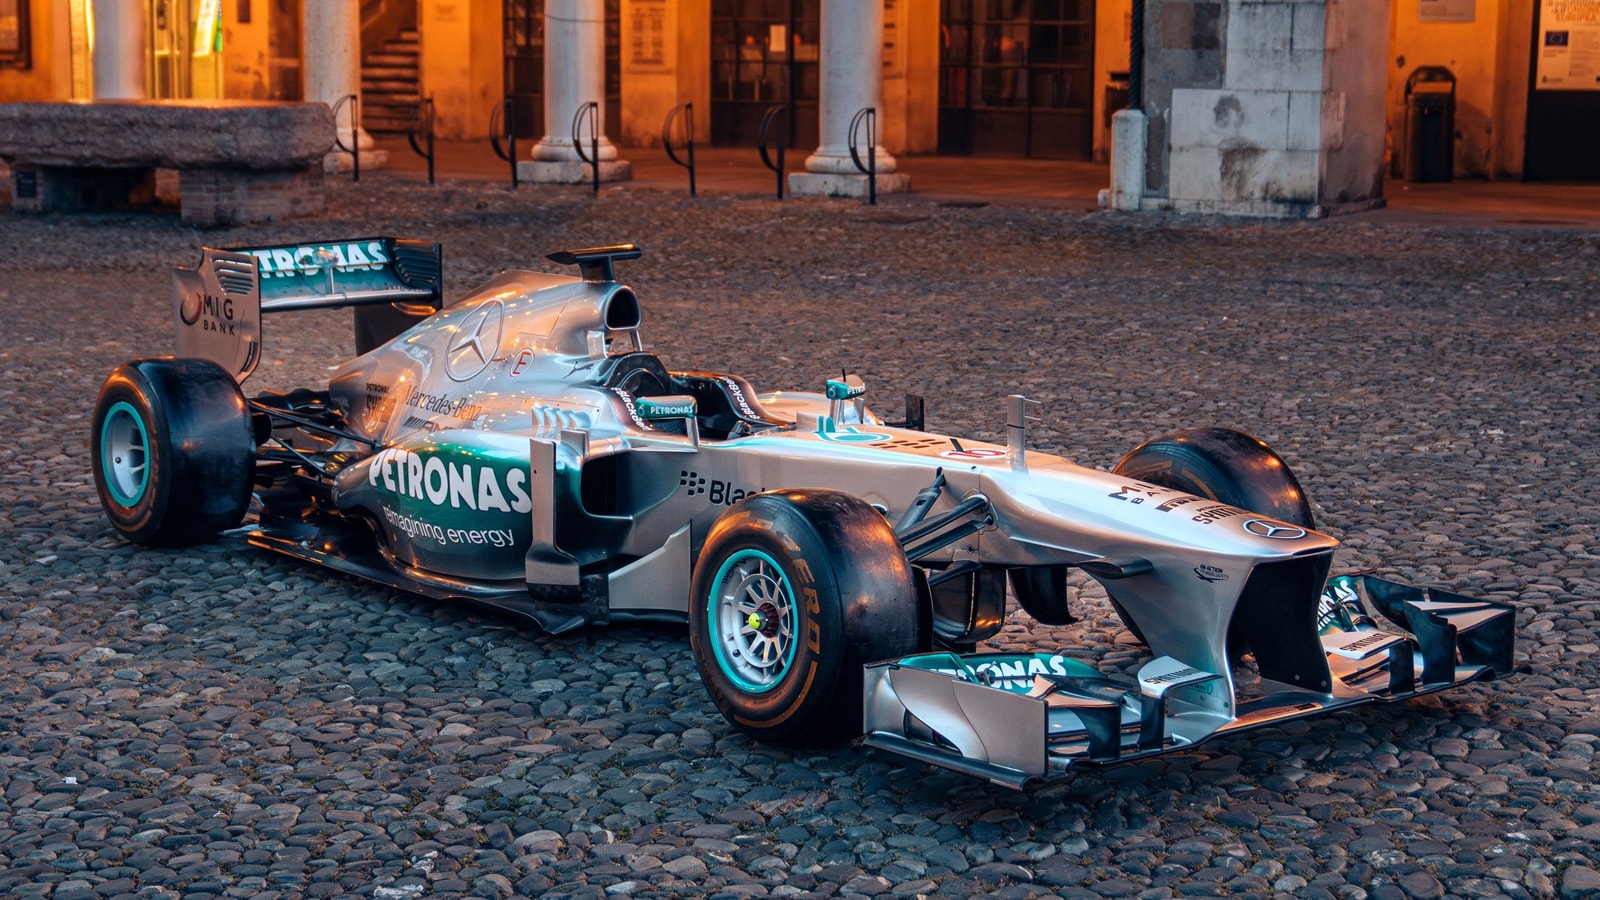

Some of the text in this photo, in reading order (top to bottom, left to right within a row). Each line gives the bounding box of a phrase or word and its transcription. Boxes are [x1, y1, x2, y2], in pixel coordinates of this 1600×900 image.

[203, 298, 234, 320] MIG
[203, 323, 236, 336] BANK
[512, 351, 532, 375] E
[402, 385, 482, 421] Mercedes-Benz
[650, 405, 693, 415] PETRONAS
[368, 448, 532, 514] PETRONAS
[709, 479, 766, 506] Bla
[1107, 482, 1153, 501] MI
[383, 504, 514, 547] reimagining energy
